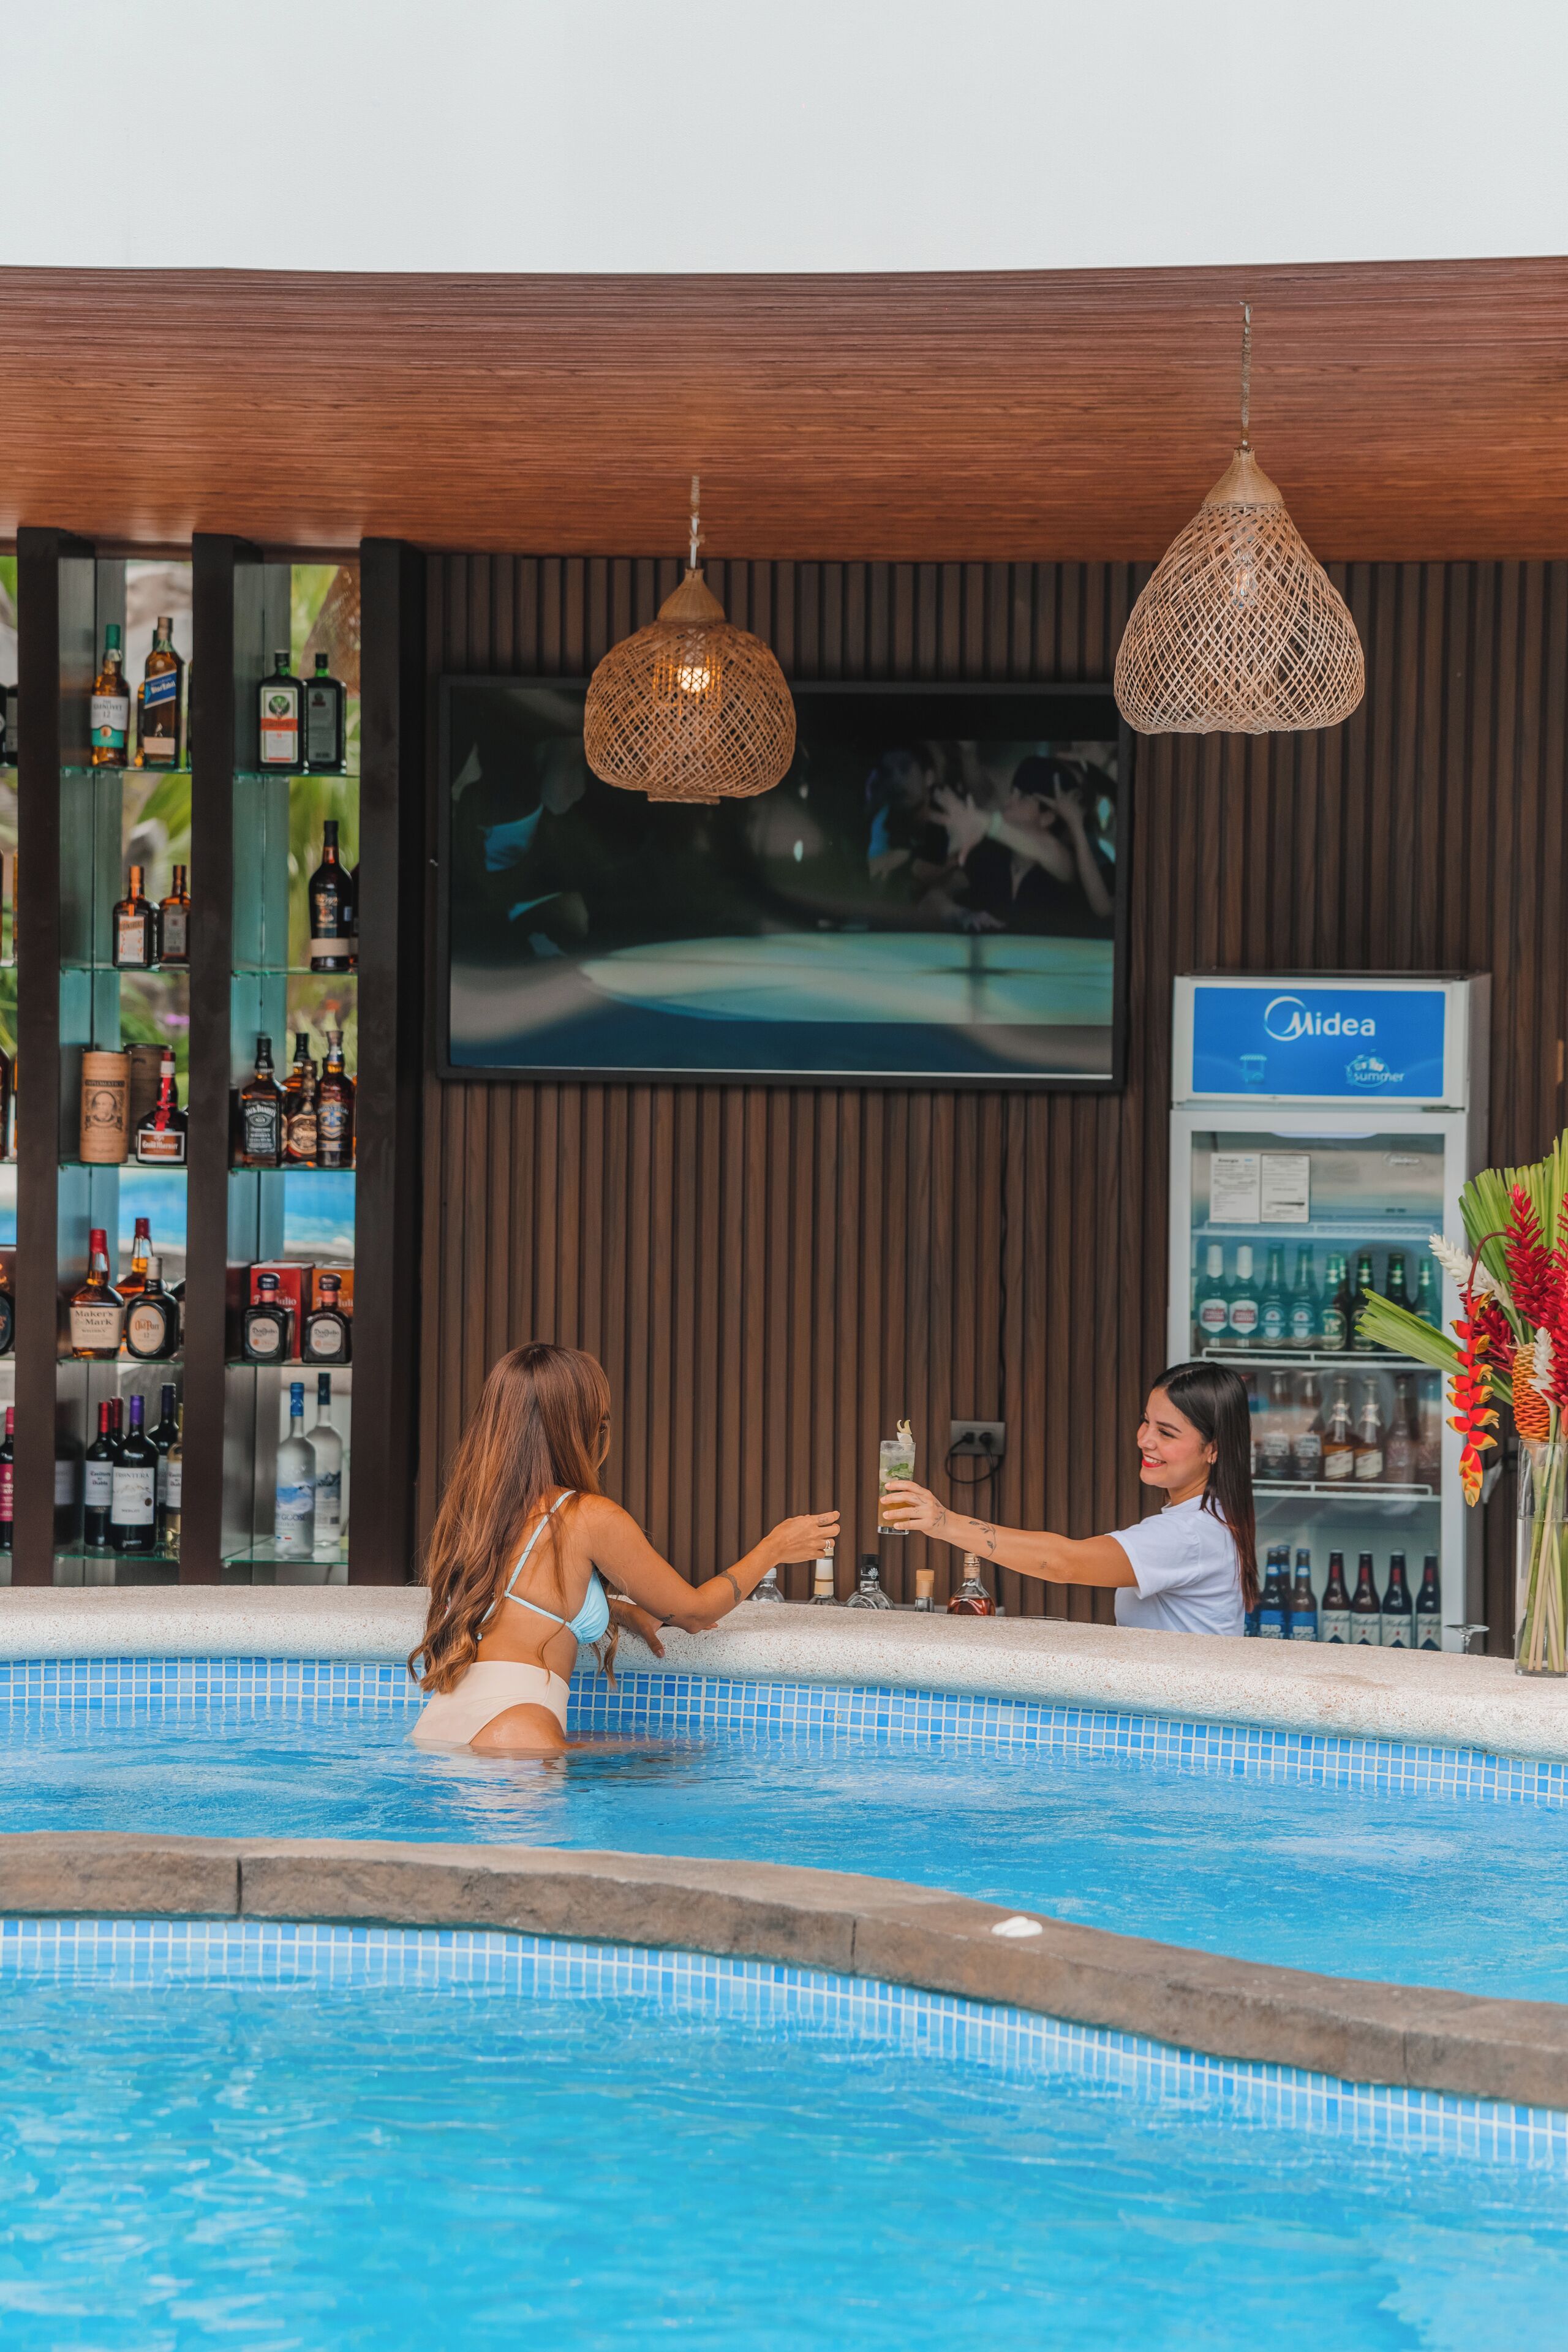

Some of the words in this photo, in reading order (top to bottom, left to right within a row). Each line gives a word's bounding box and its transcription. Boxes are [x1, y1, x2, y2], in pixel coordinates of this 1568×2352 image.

[1266, 1005, 1376, 1039] Midea
[1354, 1072, 1405, 1083] summer
[245, 1107, 257, 1117] JACK
[1260, 1624, 1281, 1632] BUD
